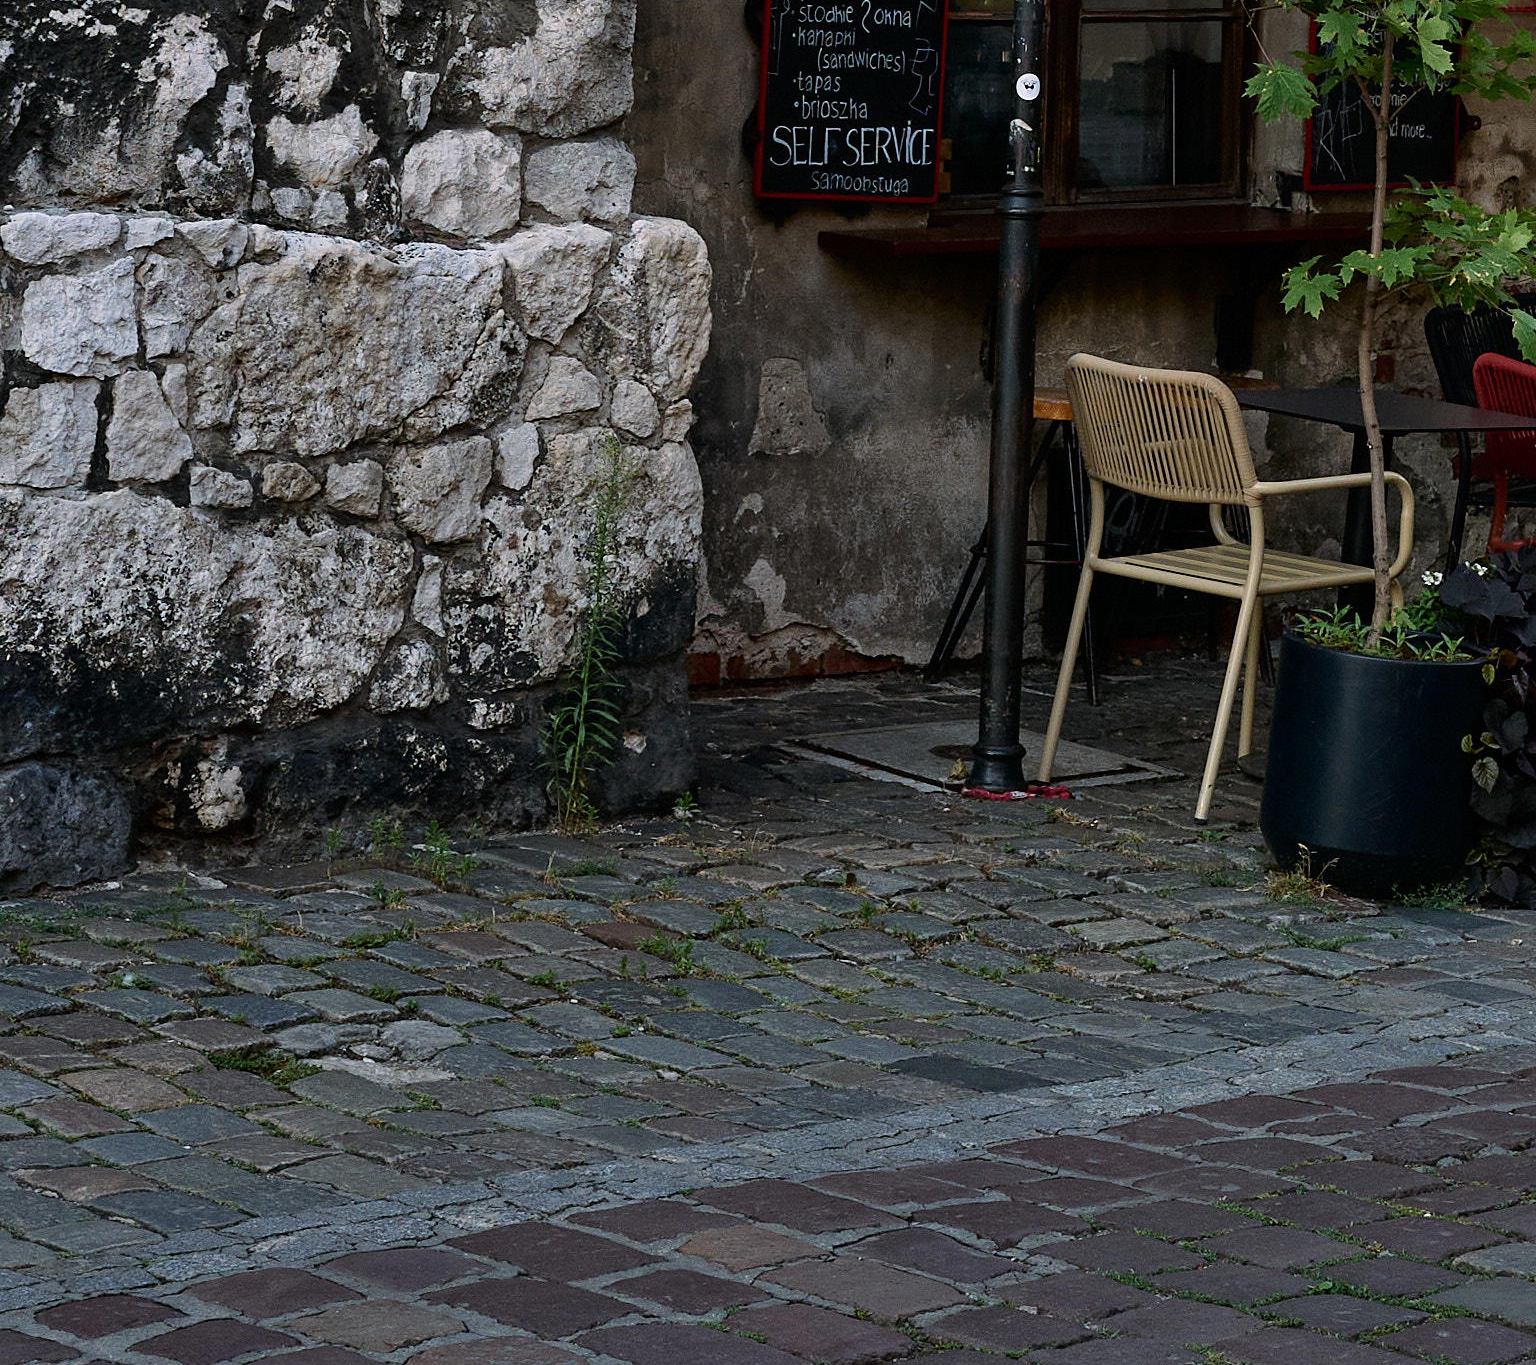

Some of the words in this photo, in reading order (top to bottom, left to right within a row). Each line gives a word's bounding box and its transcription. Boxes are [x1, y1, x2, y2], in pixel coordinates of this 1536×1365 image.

[874, 9, 912, 28] okna
[817, 47, 906, 74] (sandwiches)
[798, 71, 842, 94] tapas
[802, 94, 868, 120] brioszka
[843, 119, 935, 167] SERVICE
